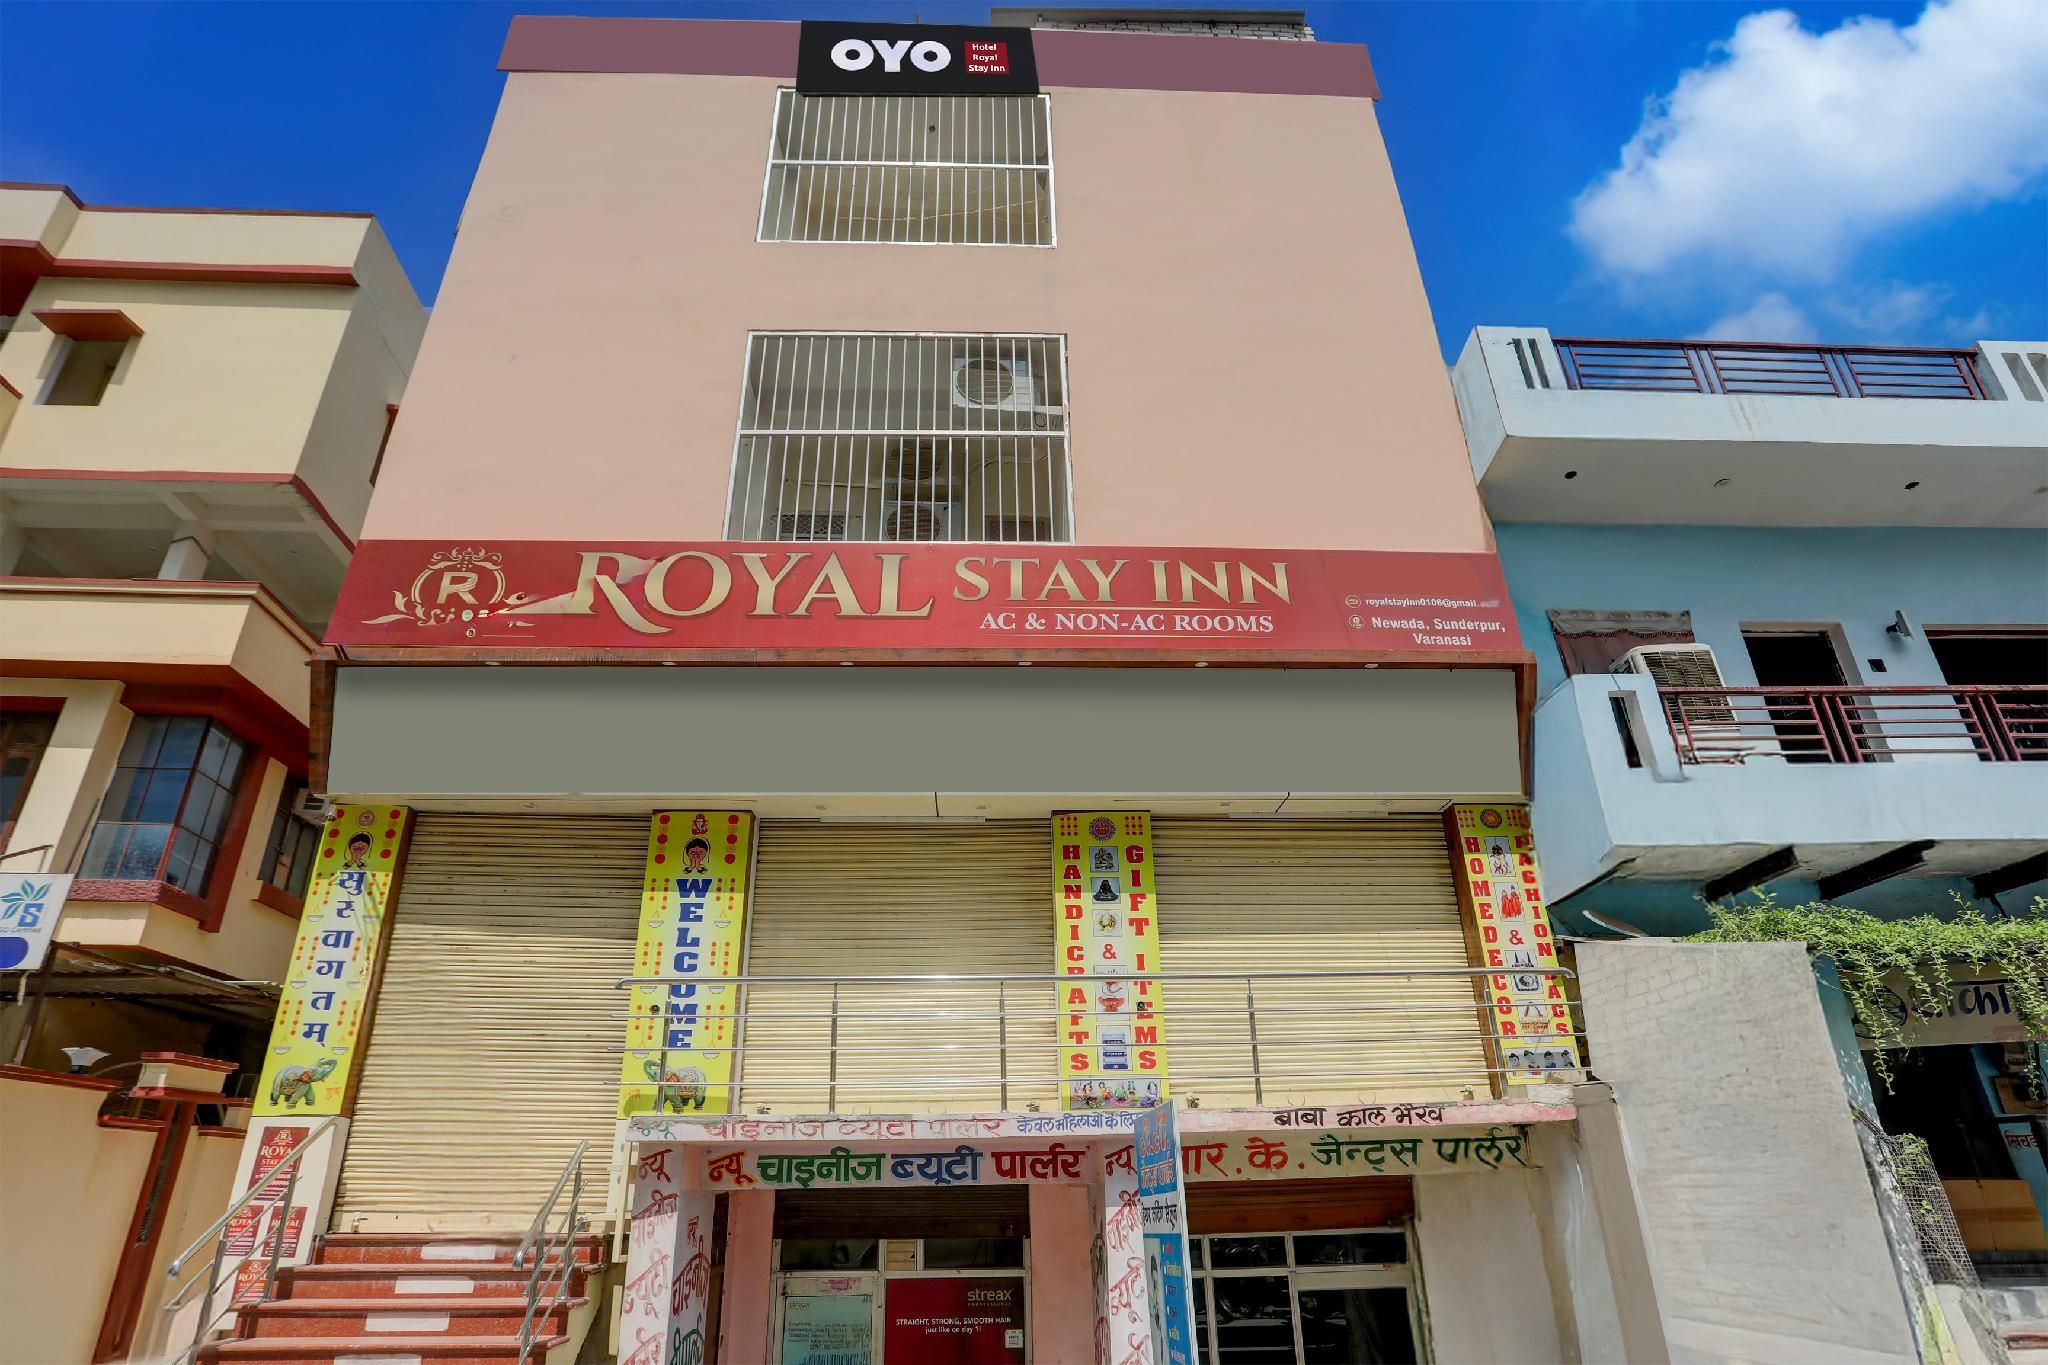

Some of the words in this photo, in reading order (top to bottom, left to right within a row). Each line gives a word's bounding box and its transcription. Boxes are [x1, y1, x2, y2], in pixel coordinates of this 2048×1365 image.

[831, 39, 951, 72] OYO
[972, 43, 997, 51] Hotel
[972, 54, 998, 62] Royal
[968, 64, 989, 74] Stay
[990, 64, 1006, 72] Inn
[560, 551, 935, 634] ROYAL
[953, 557, 1130, 602] STAY
[1147, 560, 1291, 604] INN
[979, 612, 1016, 630] AC
[1024, 614, 1046, 630] &
[1056, 613, 1165, 632] NON-AC
[1174, 614, 1273, 632] ROOMS
[1372, 617, 1429, 630] Newada,
[1434, 618, 1506, 632] Sunderpur,
[1413, 633, 1472, 646] Varanasi
[1125, 845, 1150, 936] GIFT
[1509, 929, 1524, 945] &
[1102, 943, 1118, 960] &
[668, 878, 713, 1048] WELCOME
[1133, 953, 1158, 1070] ITEMS
[1120, 1111, 1143, 1129] लि
[1273, 1107, 1327, 1127] बाबा
[1337, 1106, 1386, 1127] काल
[260, 1145, 297, 1159] ROYA
[1432, 1126, 1528, 1169] पार्लर
[708, 1151, 755, 1185] न्यू
[757, 1146, 887, 1189] चाइनीज
[890, 1145, 983, 1185] ब्यूटी
[990, 1143, 1086, 1180] पार्लर
[968, 1288, 1013, 1302] streax
[895, 1318, 930, 1327] STRAIGHT,
[931, 1317, 962, 1326] STRONG,
[963, 1317, 994, 1325] SMOOTH
[925, 1326, 939, 1335] just
[961, 1326, 974, 1335] day
